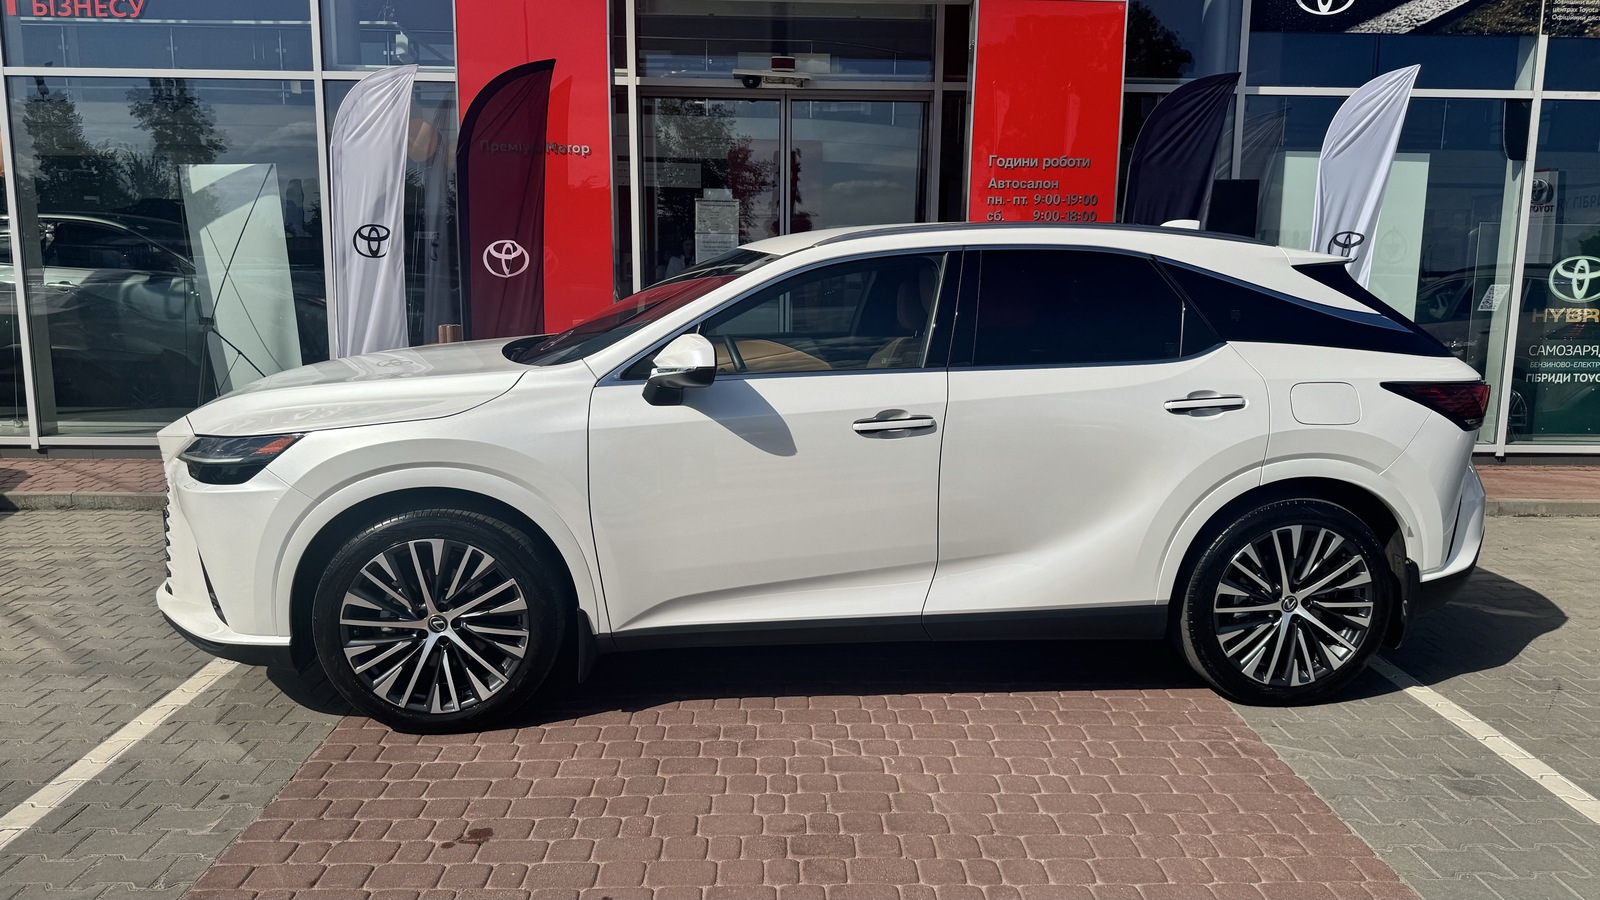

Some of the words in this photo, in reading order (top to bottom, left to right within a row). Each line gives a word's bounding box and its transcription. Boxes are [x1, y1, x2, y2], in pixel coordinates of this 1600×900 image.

[32, 0, 144, 18] БІЗНЕСУ
[988, 155, 1039, 169] Години
[1042, 155, 1091, 169] роботи
[988, 177, 1059, 189] Автосалон
[1034, 193, 1098, 206] 9:00-19:00
[987, 210, 1005, 221] сб.
[1033, 210, 1097, 221] 9:00-18:00
[1529, 345, 1600, 357] САМОЗАРЯ
[1526, 373, 1571, 383] ГІБРИДИ
